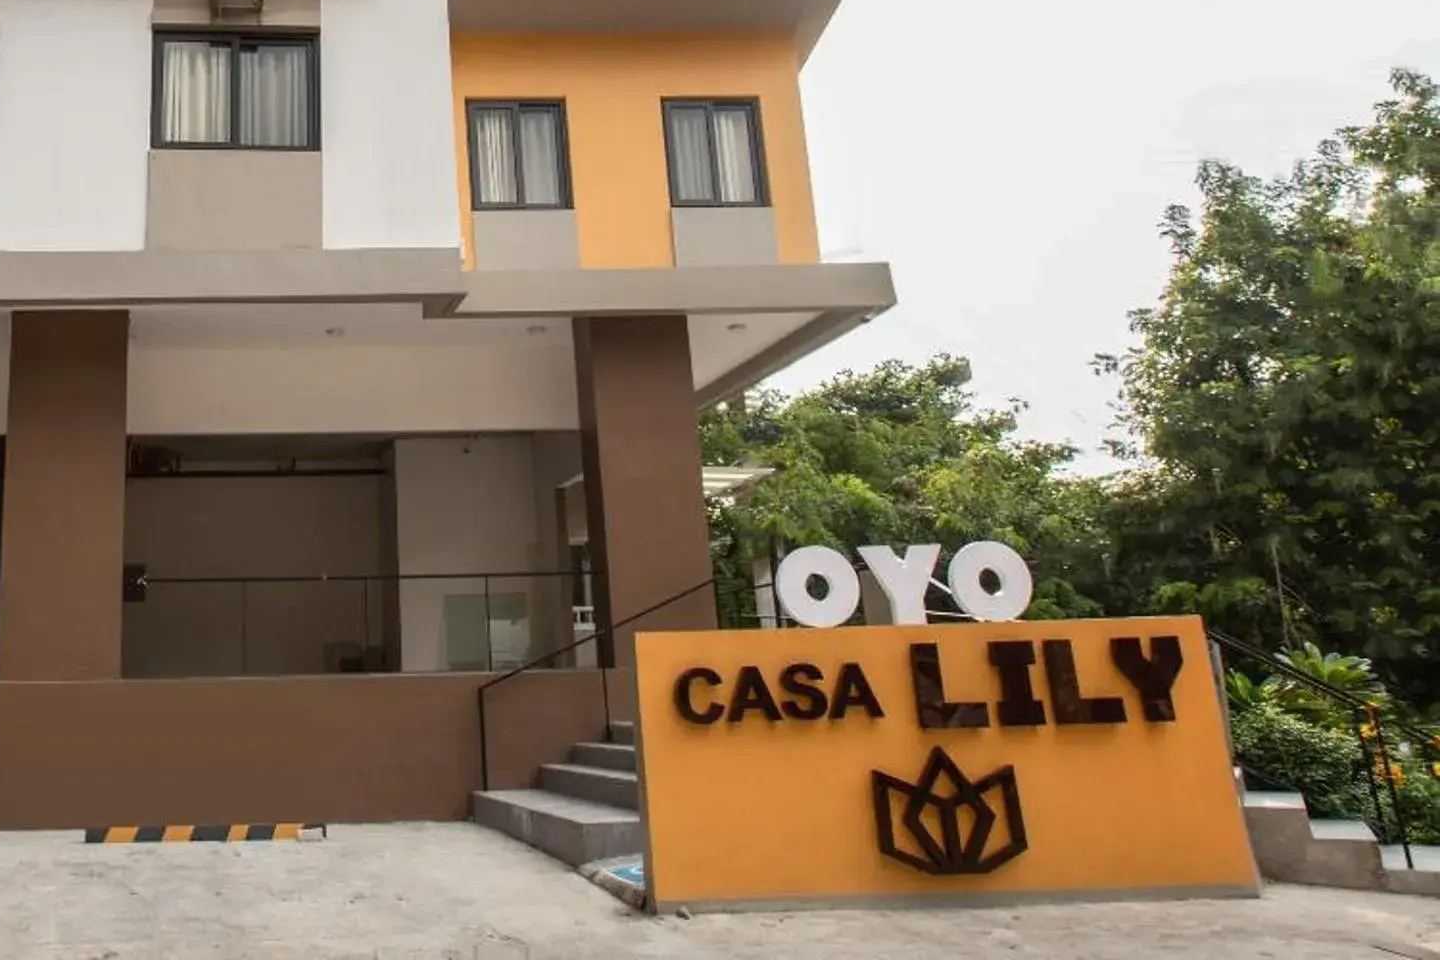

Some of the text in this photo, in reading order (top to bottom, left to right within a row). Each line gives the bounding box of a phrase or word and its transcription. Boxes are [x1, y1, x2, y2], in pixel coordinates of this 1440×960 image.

[775, 540, 1033, 628] OYO
[674, 636, 1183, 729] CASA LILY
